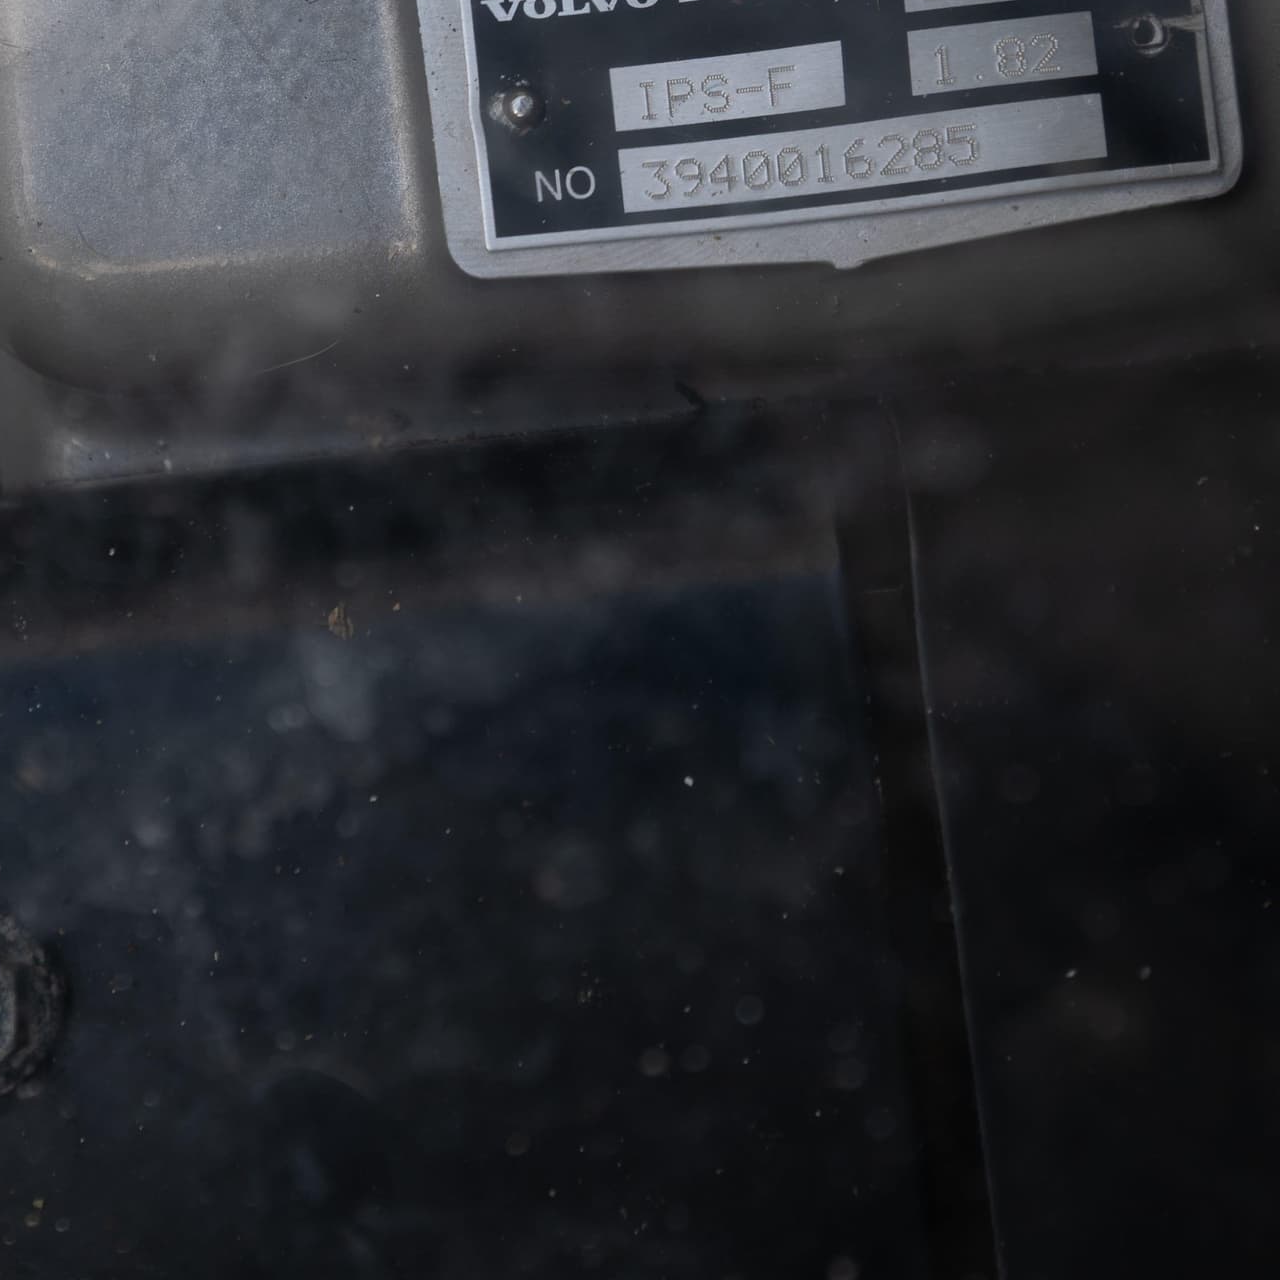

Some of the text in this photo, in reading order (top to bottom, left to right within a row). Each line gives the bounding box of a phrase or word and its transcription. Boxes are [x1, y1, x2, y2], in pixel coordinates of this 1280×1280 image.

[638, 64, 797, 121] IPS-F
[533, 121, 980, 203] NO 3940016285
